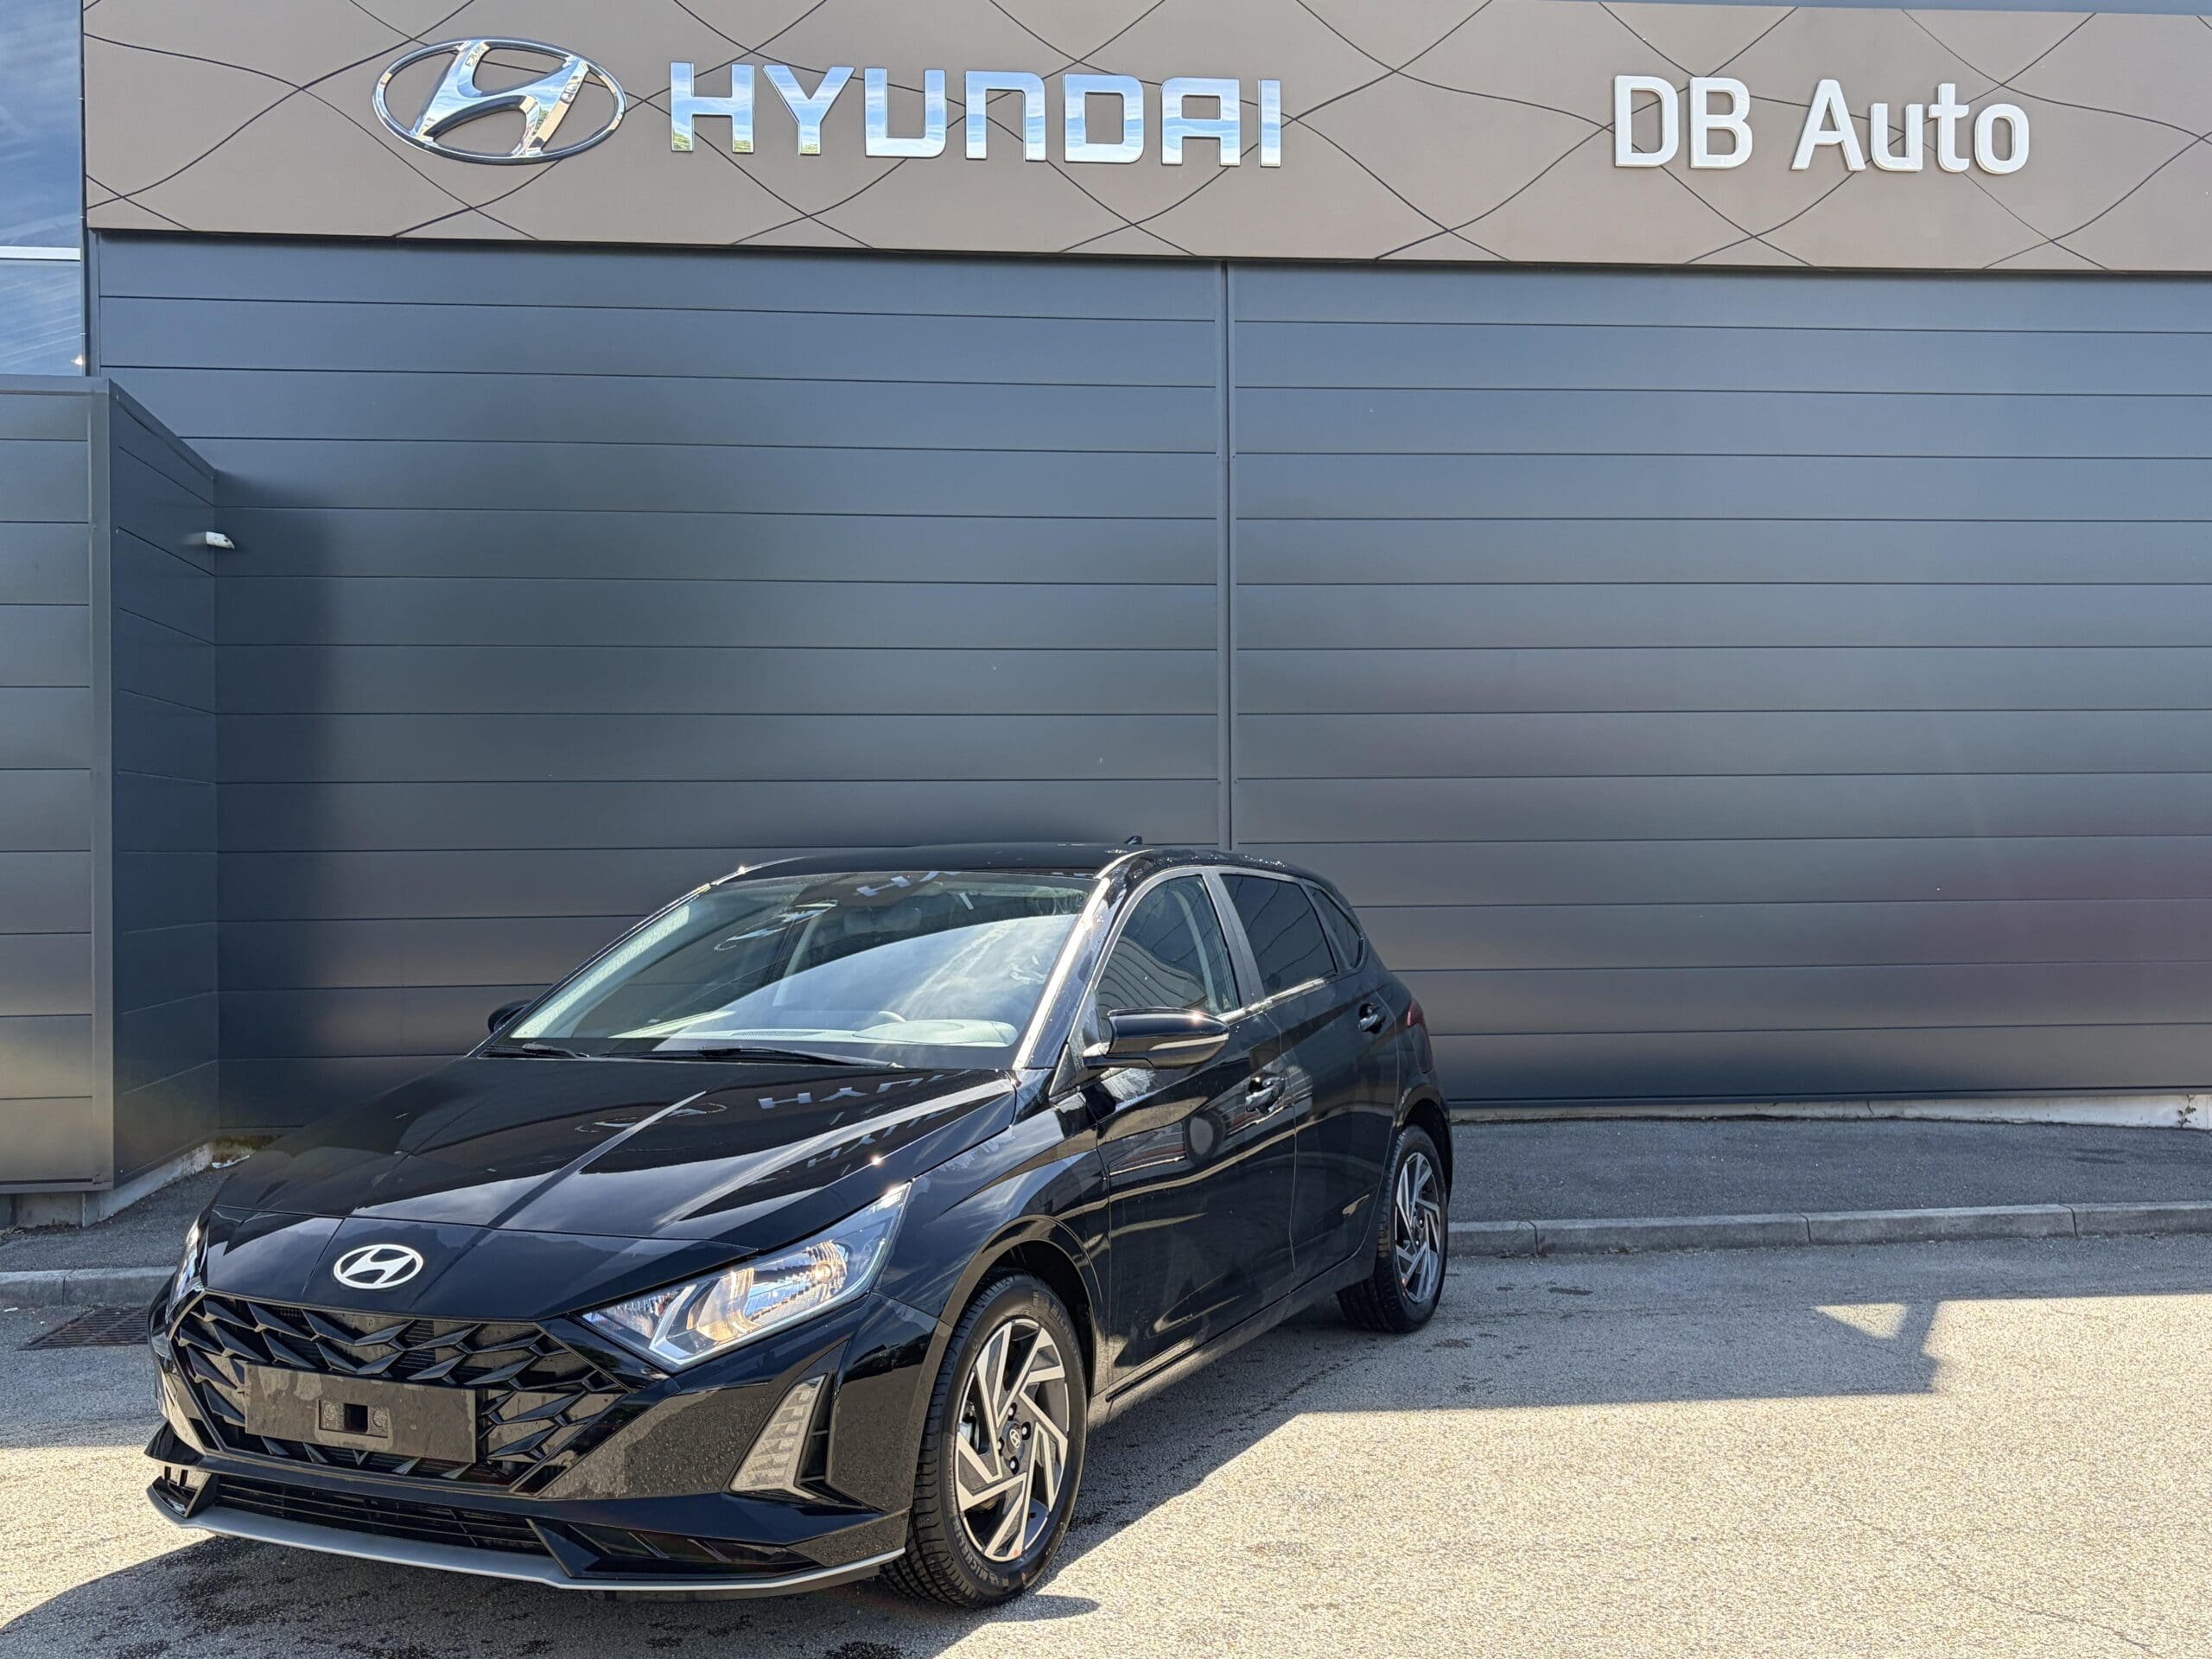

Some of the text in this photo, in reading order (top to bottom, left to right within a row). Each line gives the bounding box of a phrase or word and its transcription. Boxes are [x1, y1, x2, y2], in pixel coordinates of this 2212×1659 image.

[669, 60, 1281, 168] HYUNDAI
[1614, 74, 2031, 175] DB Auto
